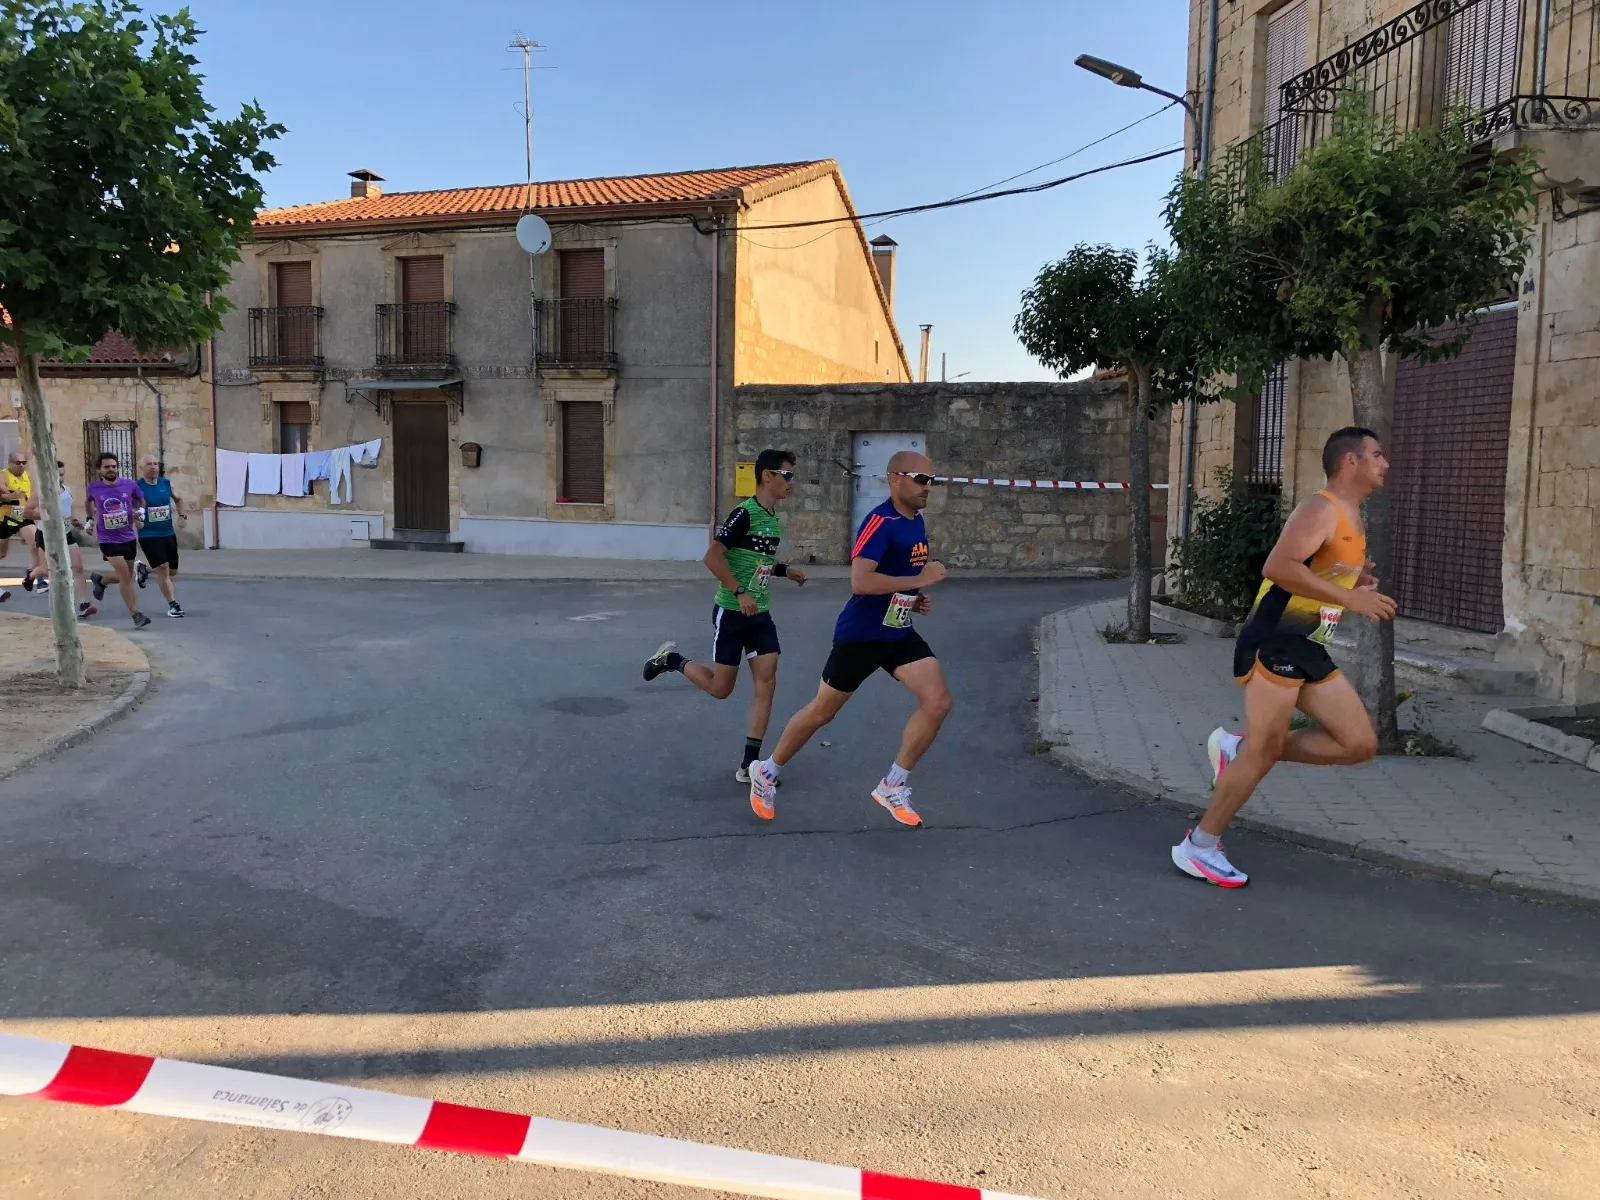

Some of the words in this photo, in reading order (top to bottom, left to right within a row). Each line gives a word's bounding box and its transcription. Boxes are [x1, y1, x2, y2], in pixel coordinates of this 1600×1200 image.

[153, 511, 166, 519] 130
[109, 517, 124, 526] 132
[896, 607, 912, 620] 15
[212, 1089, 290, 1113] Salamanca
[293, 1102, 308, 1112] de
